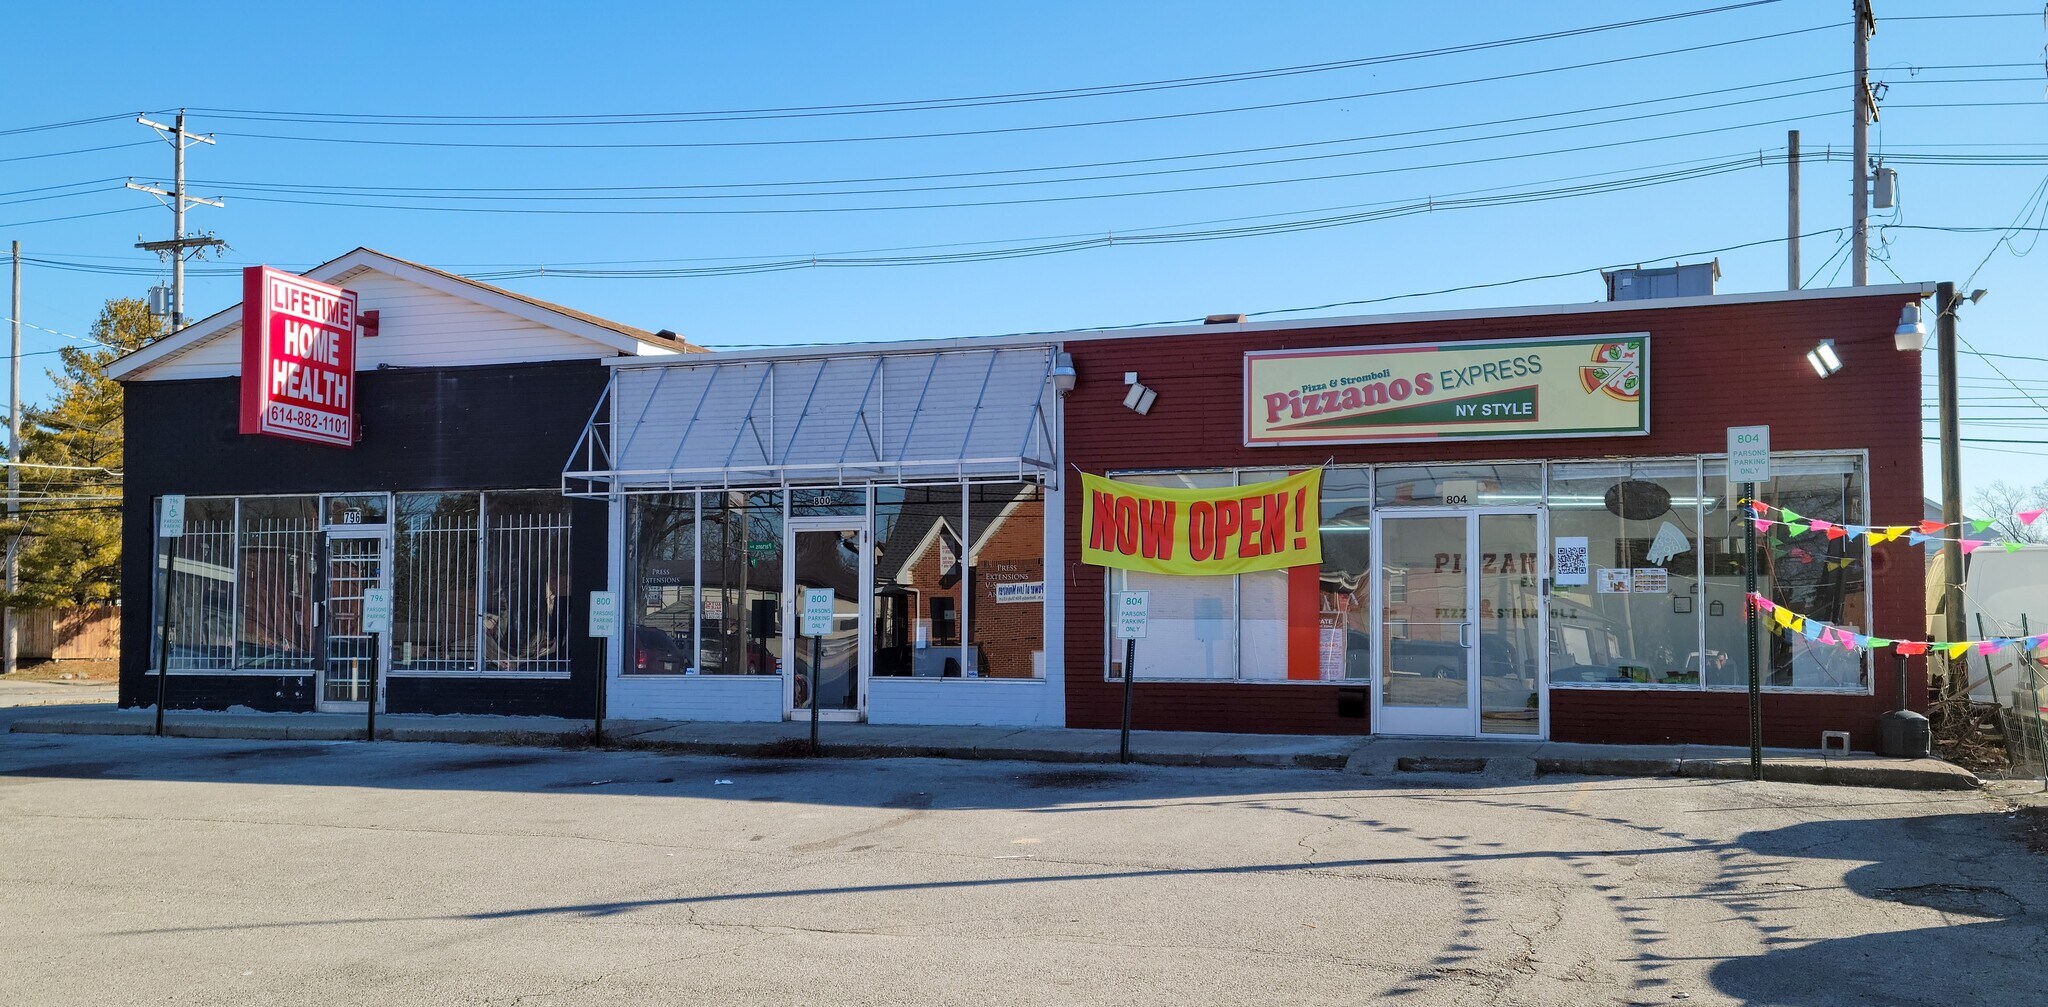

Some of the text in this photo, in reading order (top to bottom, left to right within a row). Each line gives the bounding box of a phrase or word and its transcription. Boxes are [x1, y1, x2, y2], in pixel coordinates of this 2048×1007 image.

[273, 283, 350, 327] LIFETIME
[284, 319, 340, 366] HOME
[272, 358, 347, 409] HEALTH
[1301, 368, 1391, 394] Pizza & Stromboli
[1263, 354, 1543, 423] Pizzanos EXPRESS
[1456, 402, 1533, 417] NY STYLE
[271, 405, 348, 434] 614-882-1101
[1737, 434, 1760, 444] 804
[1733, 449, 1767, 457] PARSONS
[1734, 458, 1766, 466] PARKING
[814, 496, 830, 505] 800
[1446, 494, 1467, 505] 804
[344, 511, 361, 523] 796
[1090, 488, 1177, 561] NOW
[652, 568, 670, 576] PRESS
[997, 564, 1018, 572] PRESS
[642, 576, 681, 584] EXTENSIONS
[985, 573, 1029, 581] EXTENSIONS
[596, 597, 610, 606] 800
[811, 595, 827, 603] 800
[1126, 597, 1142, 606] 804
